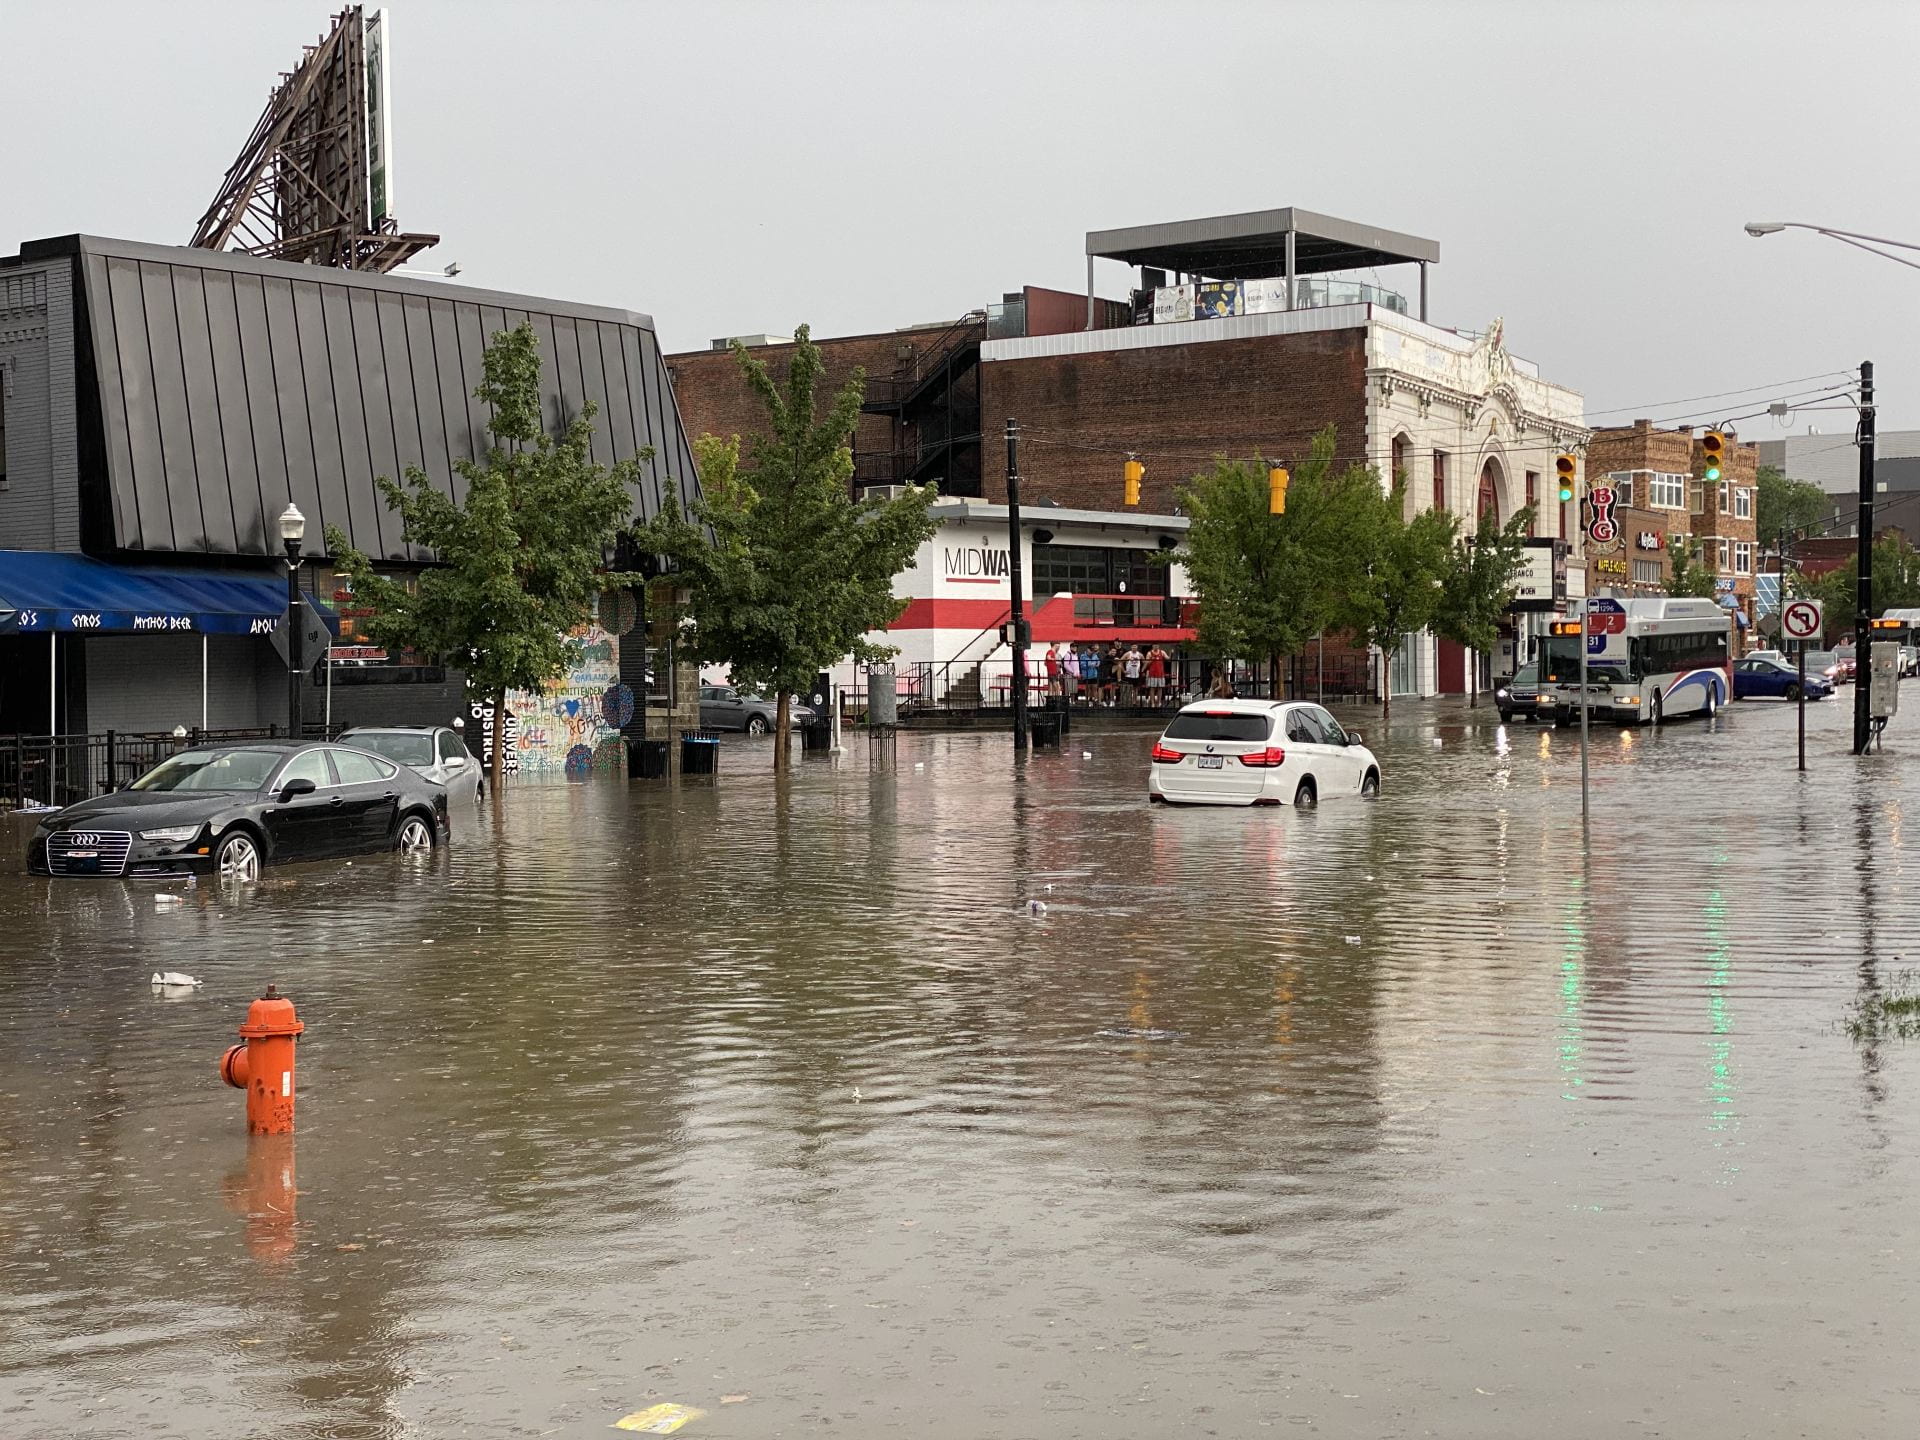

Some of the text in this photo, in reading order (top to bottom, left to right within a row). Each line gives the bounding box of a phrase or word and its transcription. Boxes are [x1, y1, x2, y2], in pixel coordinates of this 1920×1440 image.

[1593, 487, 1613, 540] BIG
[945, 547, 1010, 576] MIDWA
[71, 613, 101, 628] GYROS
[133, 615, 168, 630] MYTHOS
[170, 616, 192, 630] BEER
[1588, 615, 1614, 626] 1 2
[1588, 636, 1599, 646] 31
